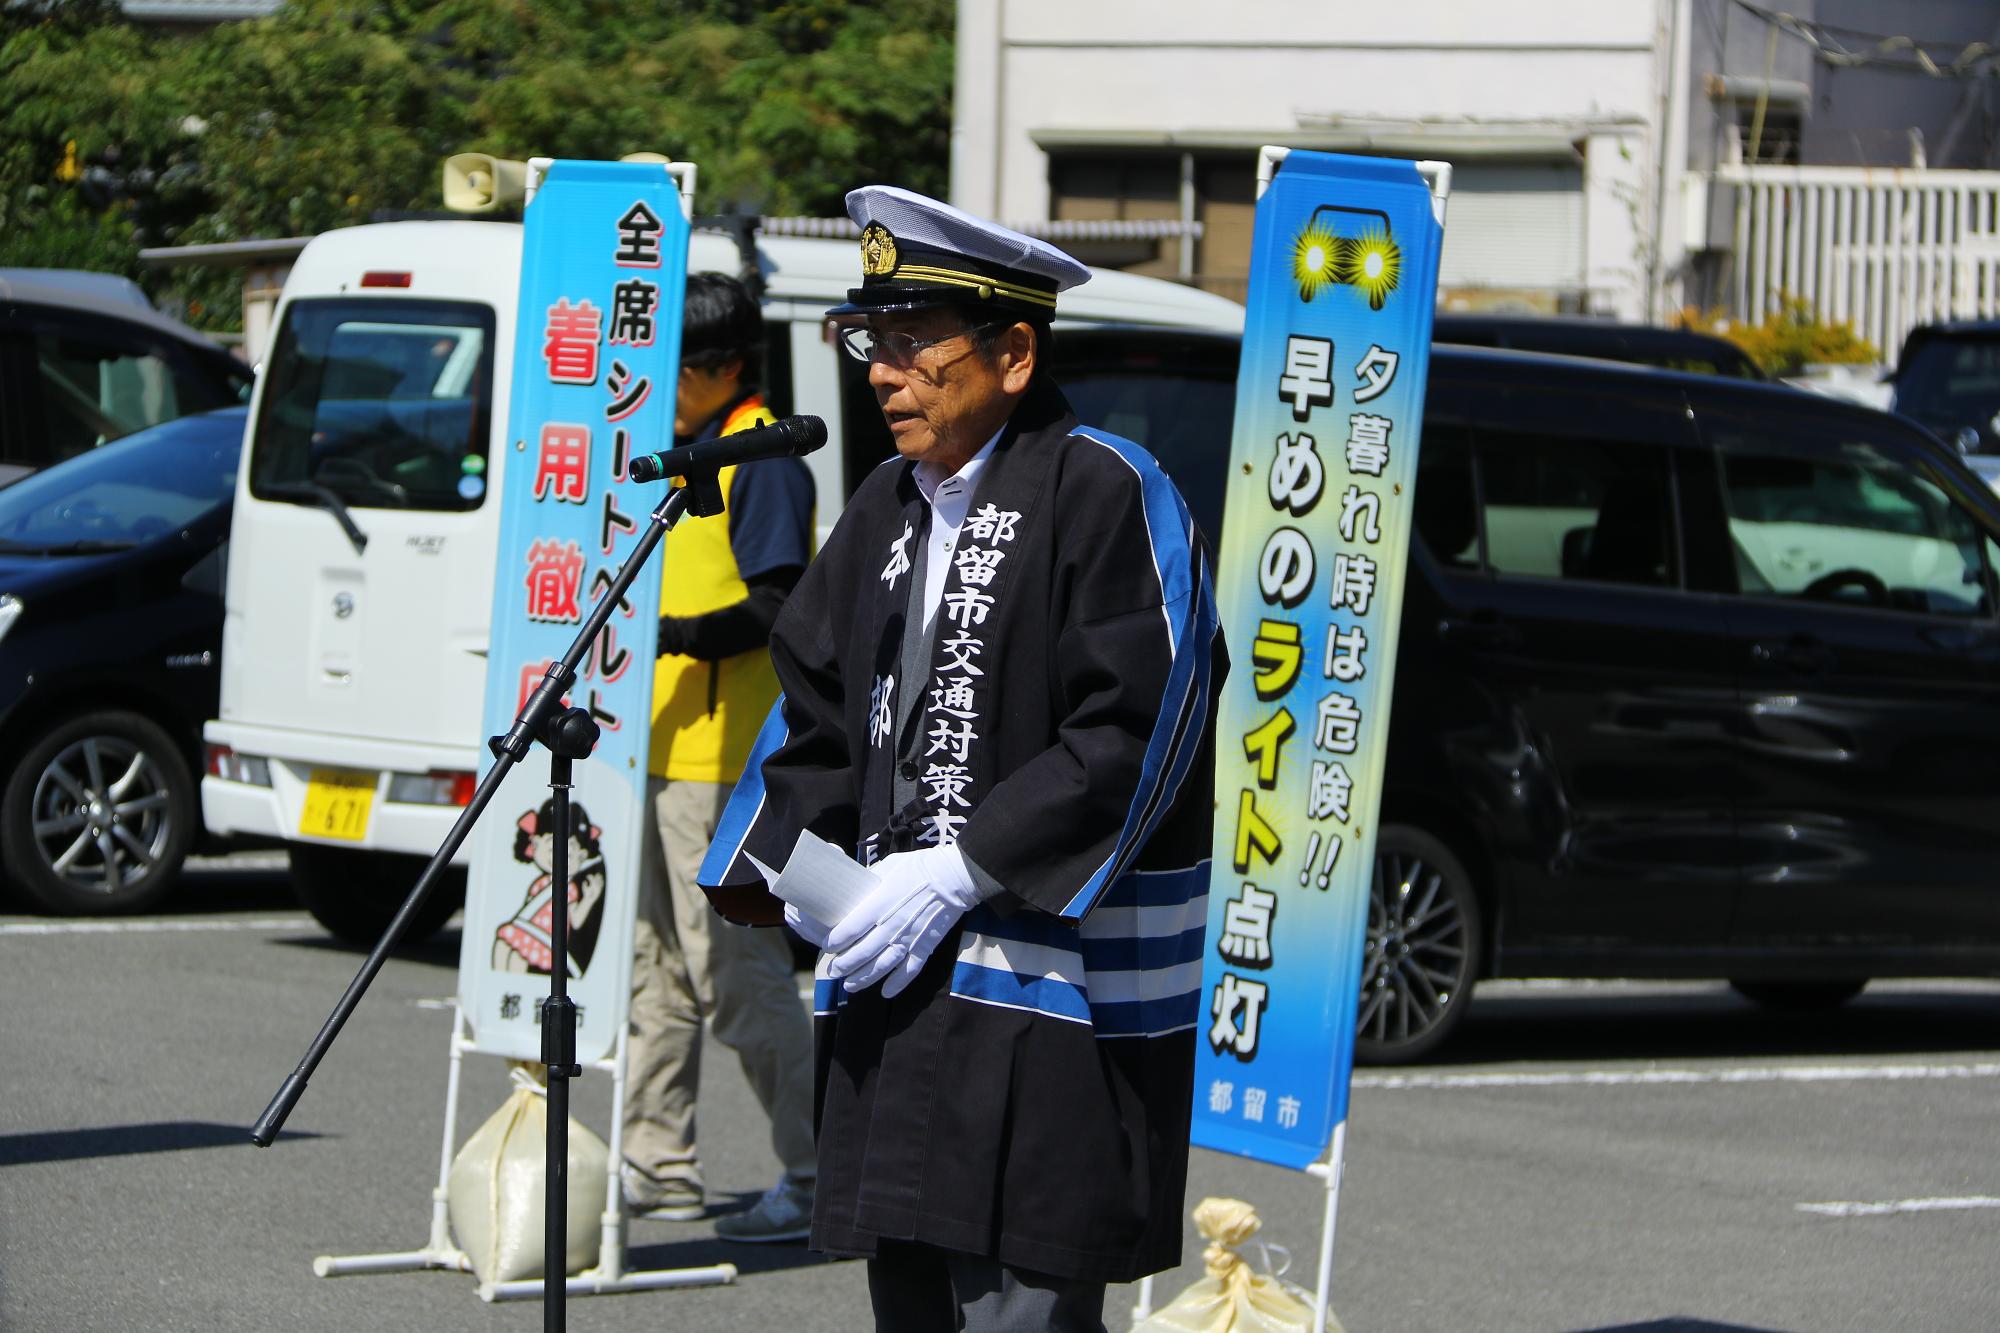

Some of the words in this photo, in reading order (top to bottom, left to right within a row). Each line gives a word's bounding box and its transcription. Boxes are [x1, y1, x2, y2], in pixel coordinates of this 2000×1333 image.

[1208, 333, 1334, 1063] 早めのライト点灯
[1208, 1079, 1301, 1130] 都留市
